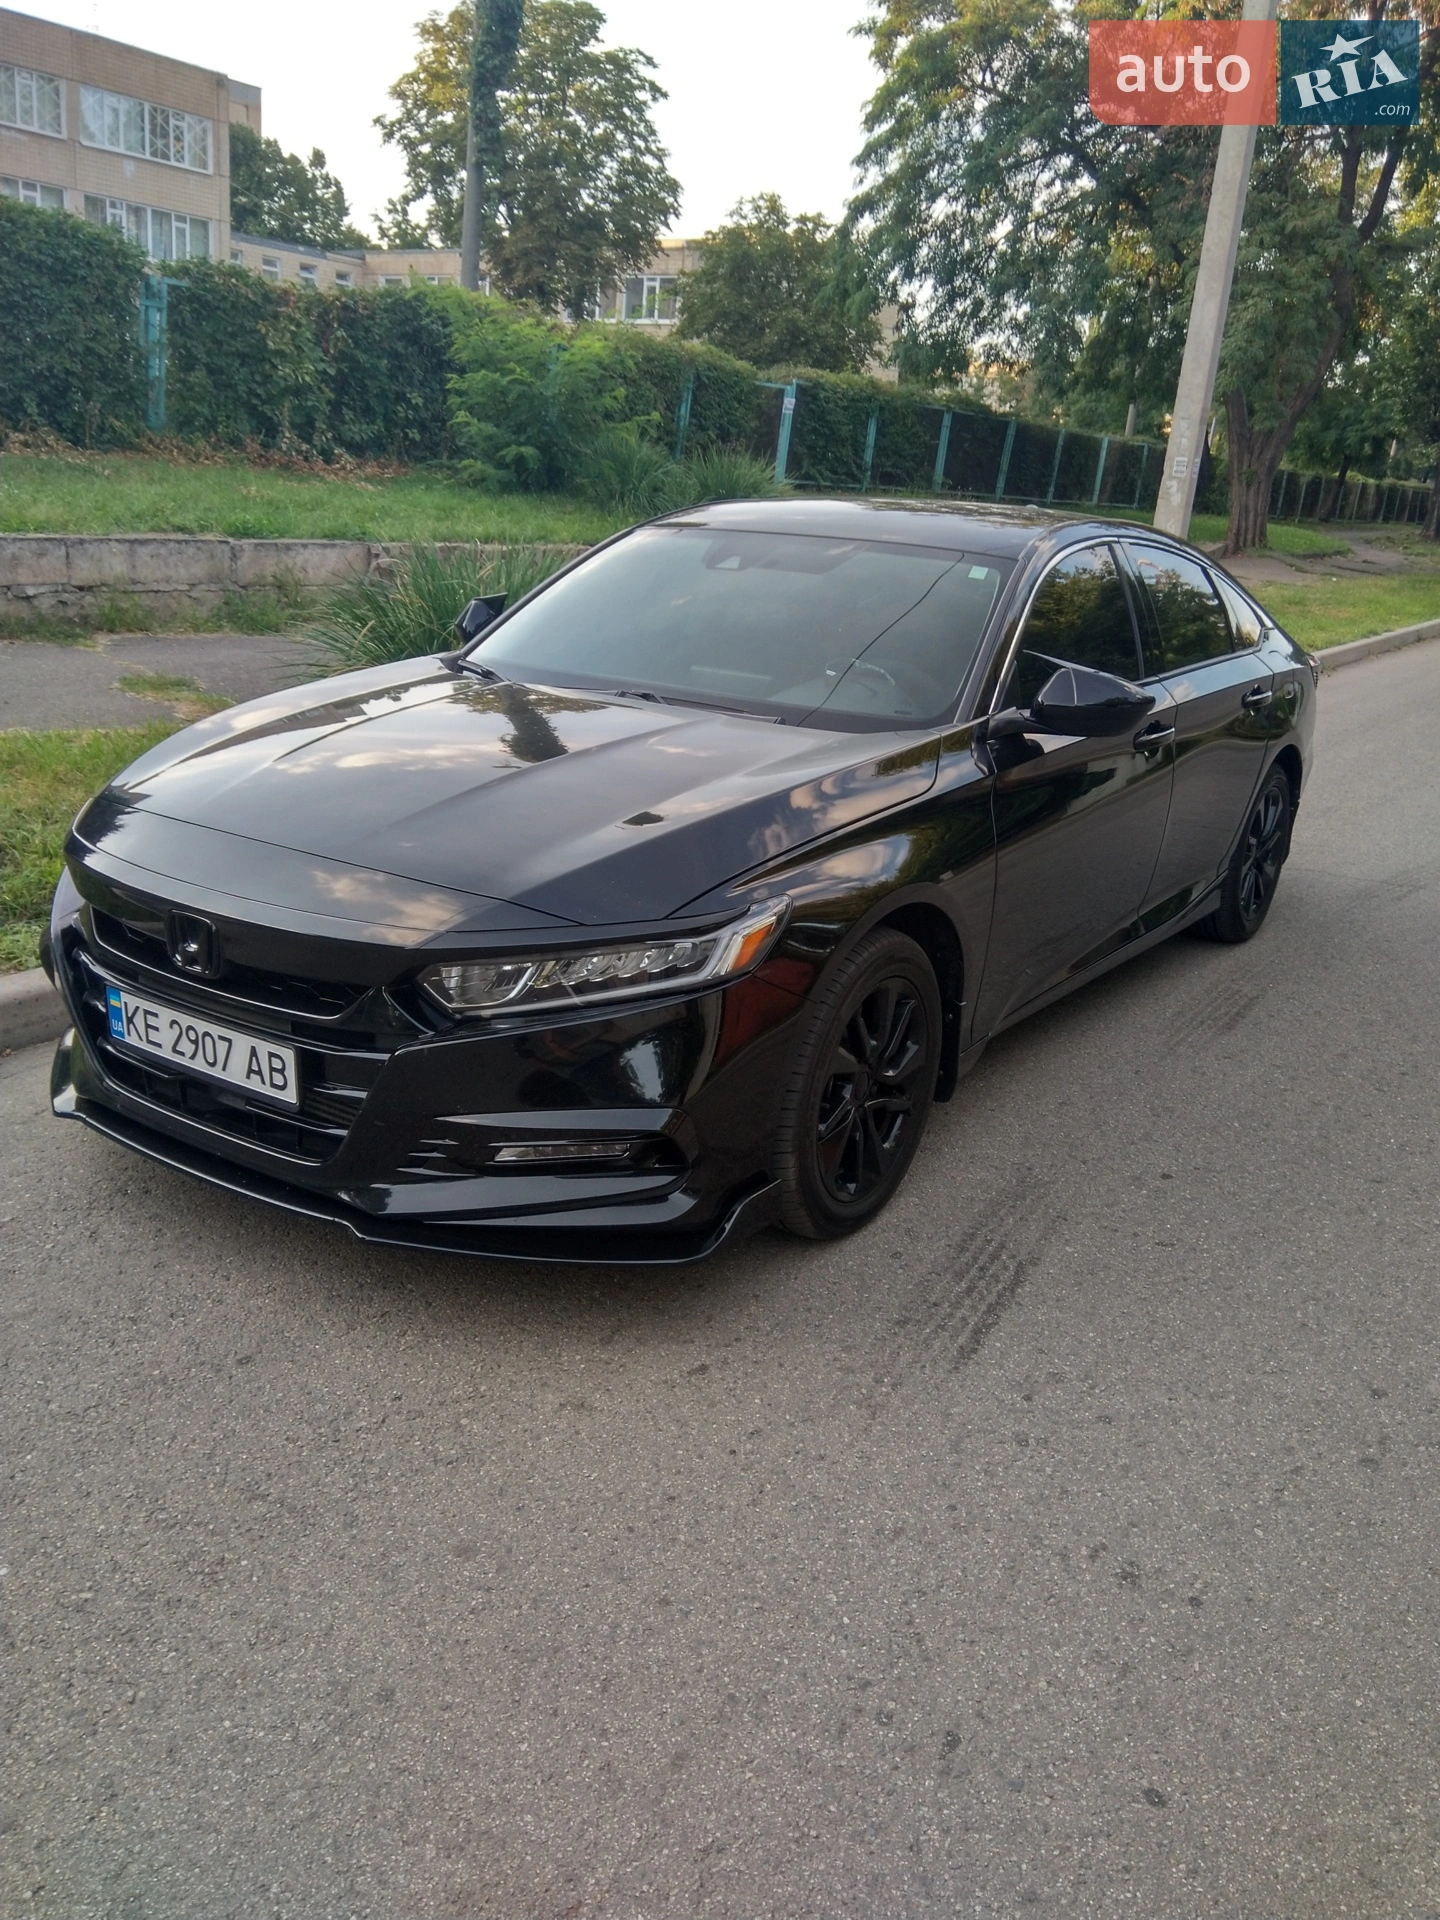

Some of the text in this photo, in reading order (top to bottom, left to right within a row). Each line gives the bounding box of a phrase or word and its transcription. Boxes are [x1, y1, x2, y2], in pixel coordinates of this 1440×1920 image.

[112, 1019, 123, 1033] UA
[124, 1001, 288, 1091] KE 2907 AB
